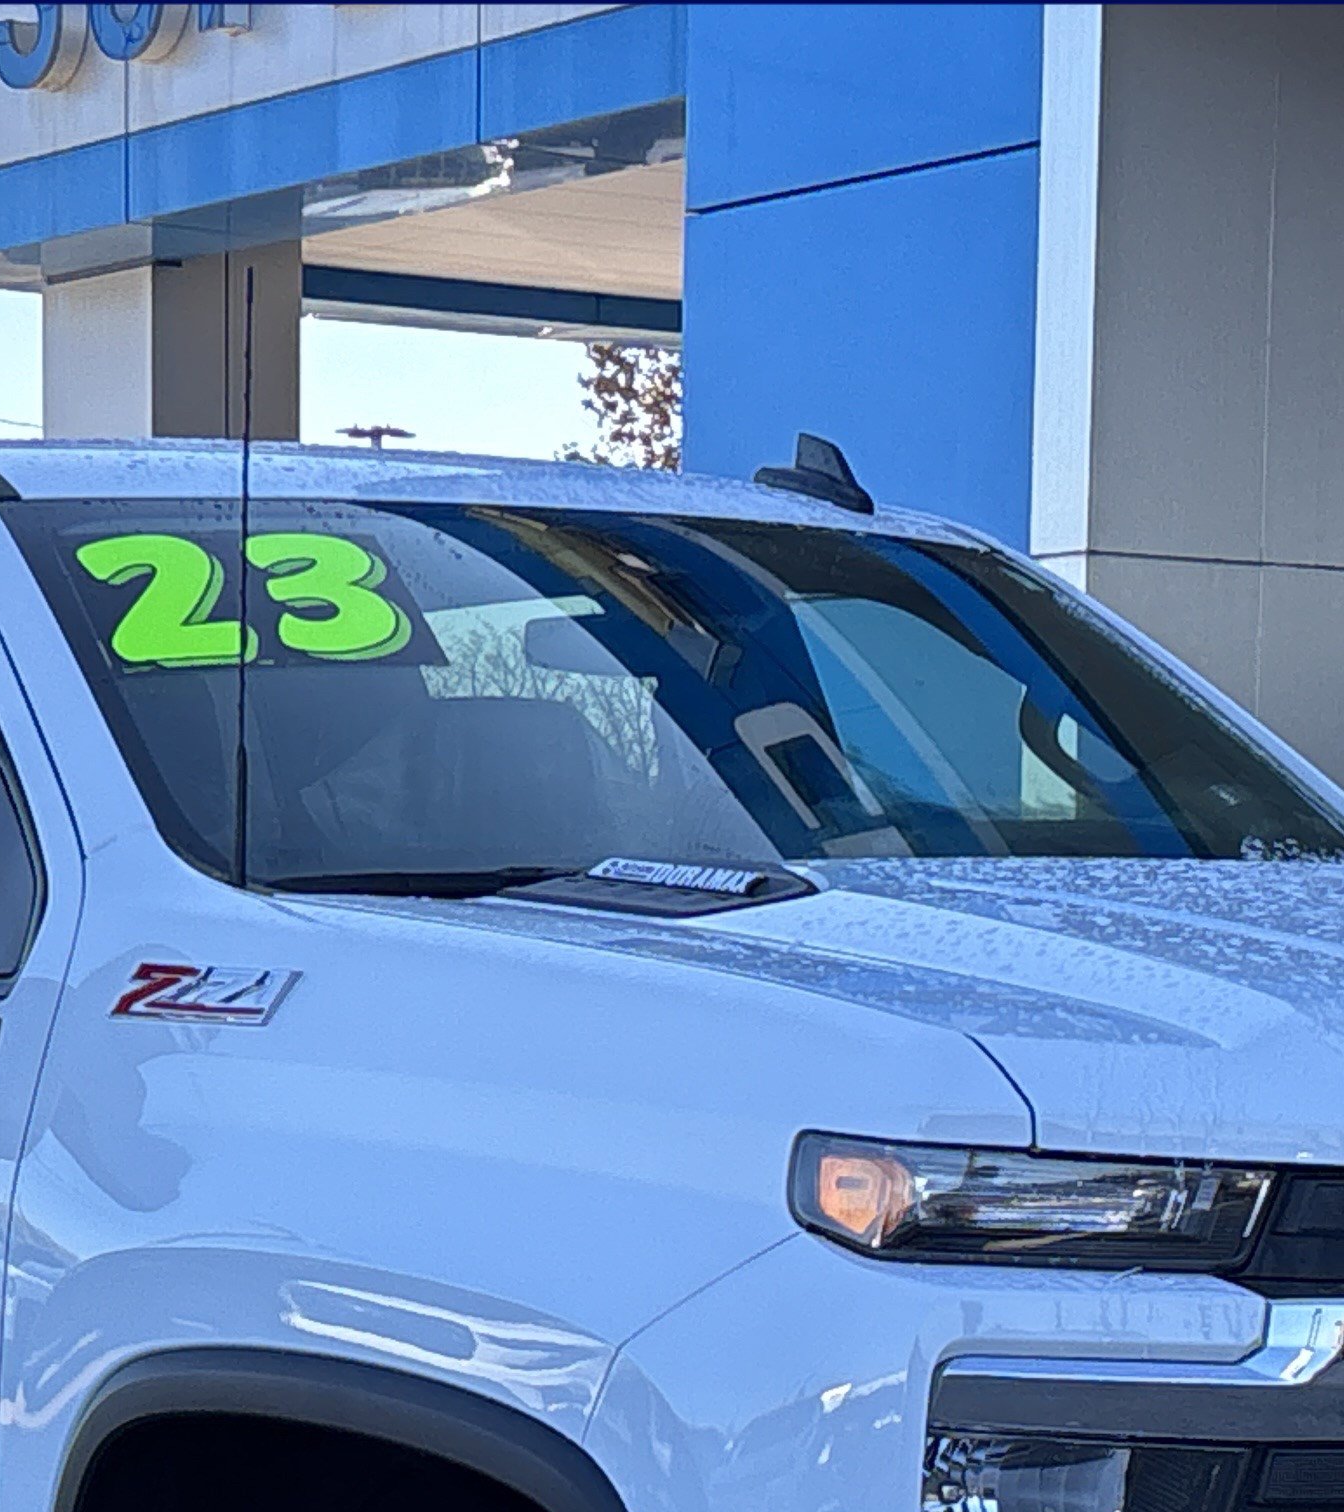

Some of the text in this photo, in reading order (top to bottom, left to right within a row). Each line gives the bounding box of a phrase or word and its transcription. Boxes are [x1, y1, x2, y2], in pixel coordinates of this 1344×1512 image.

[75, 532, 412, 668] 23
[650, 862, 759, 894] DURAMAX
[109, 962, 304, 1027] Z71
